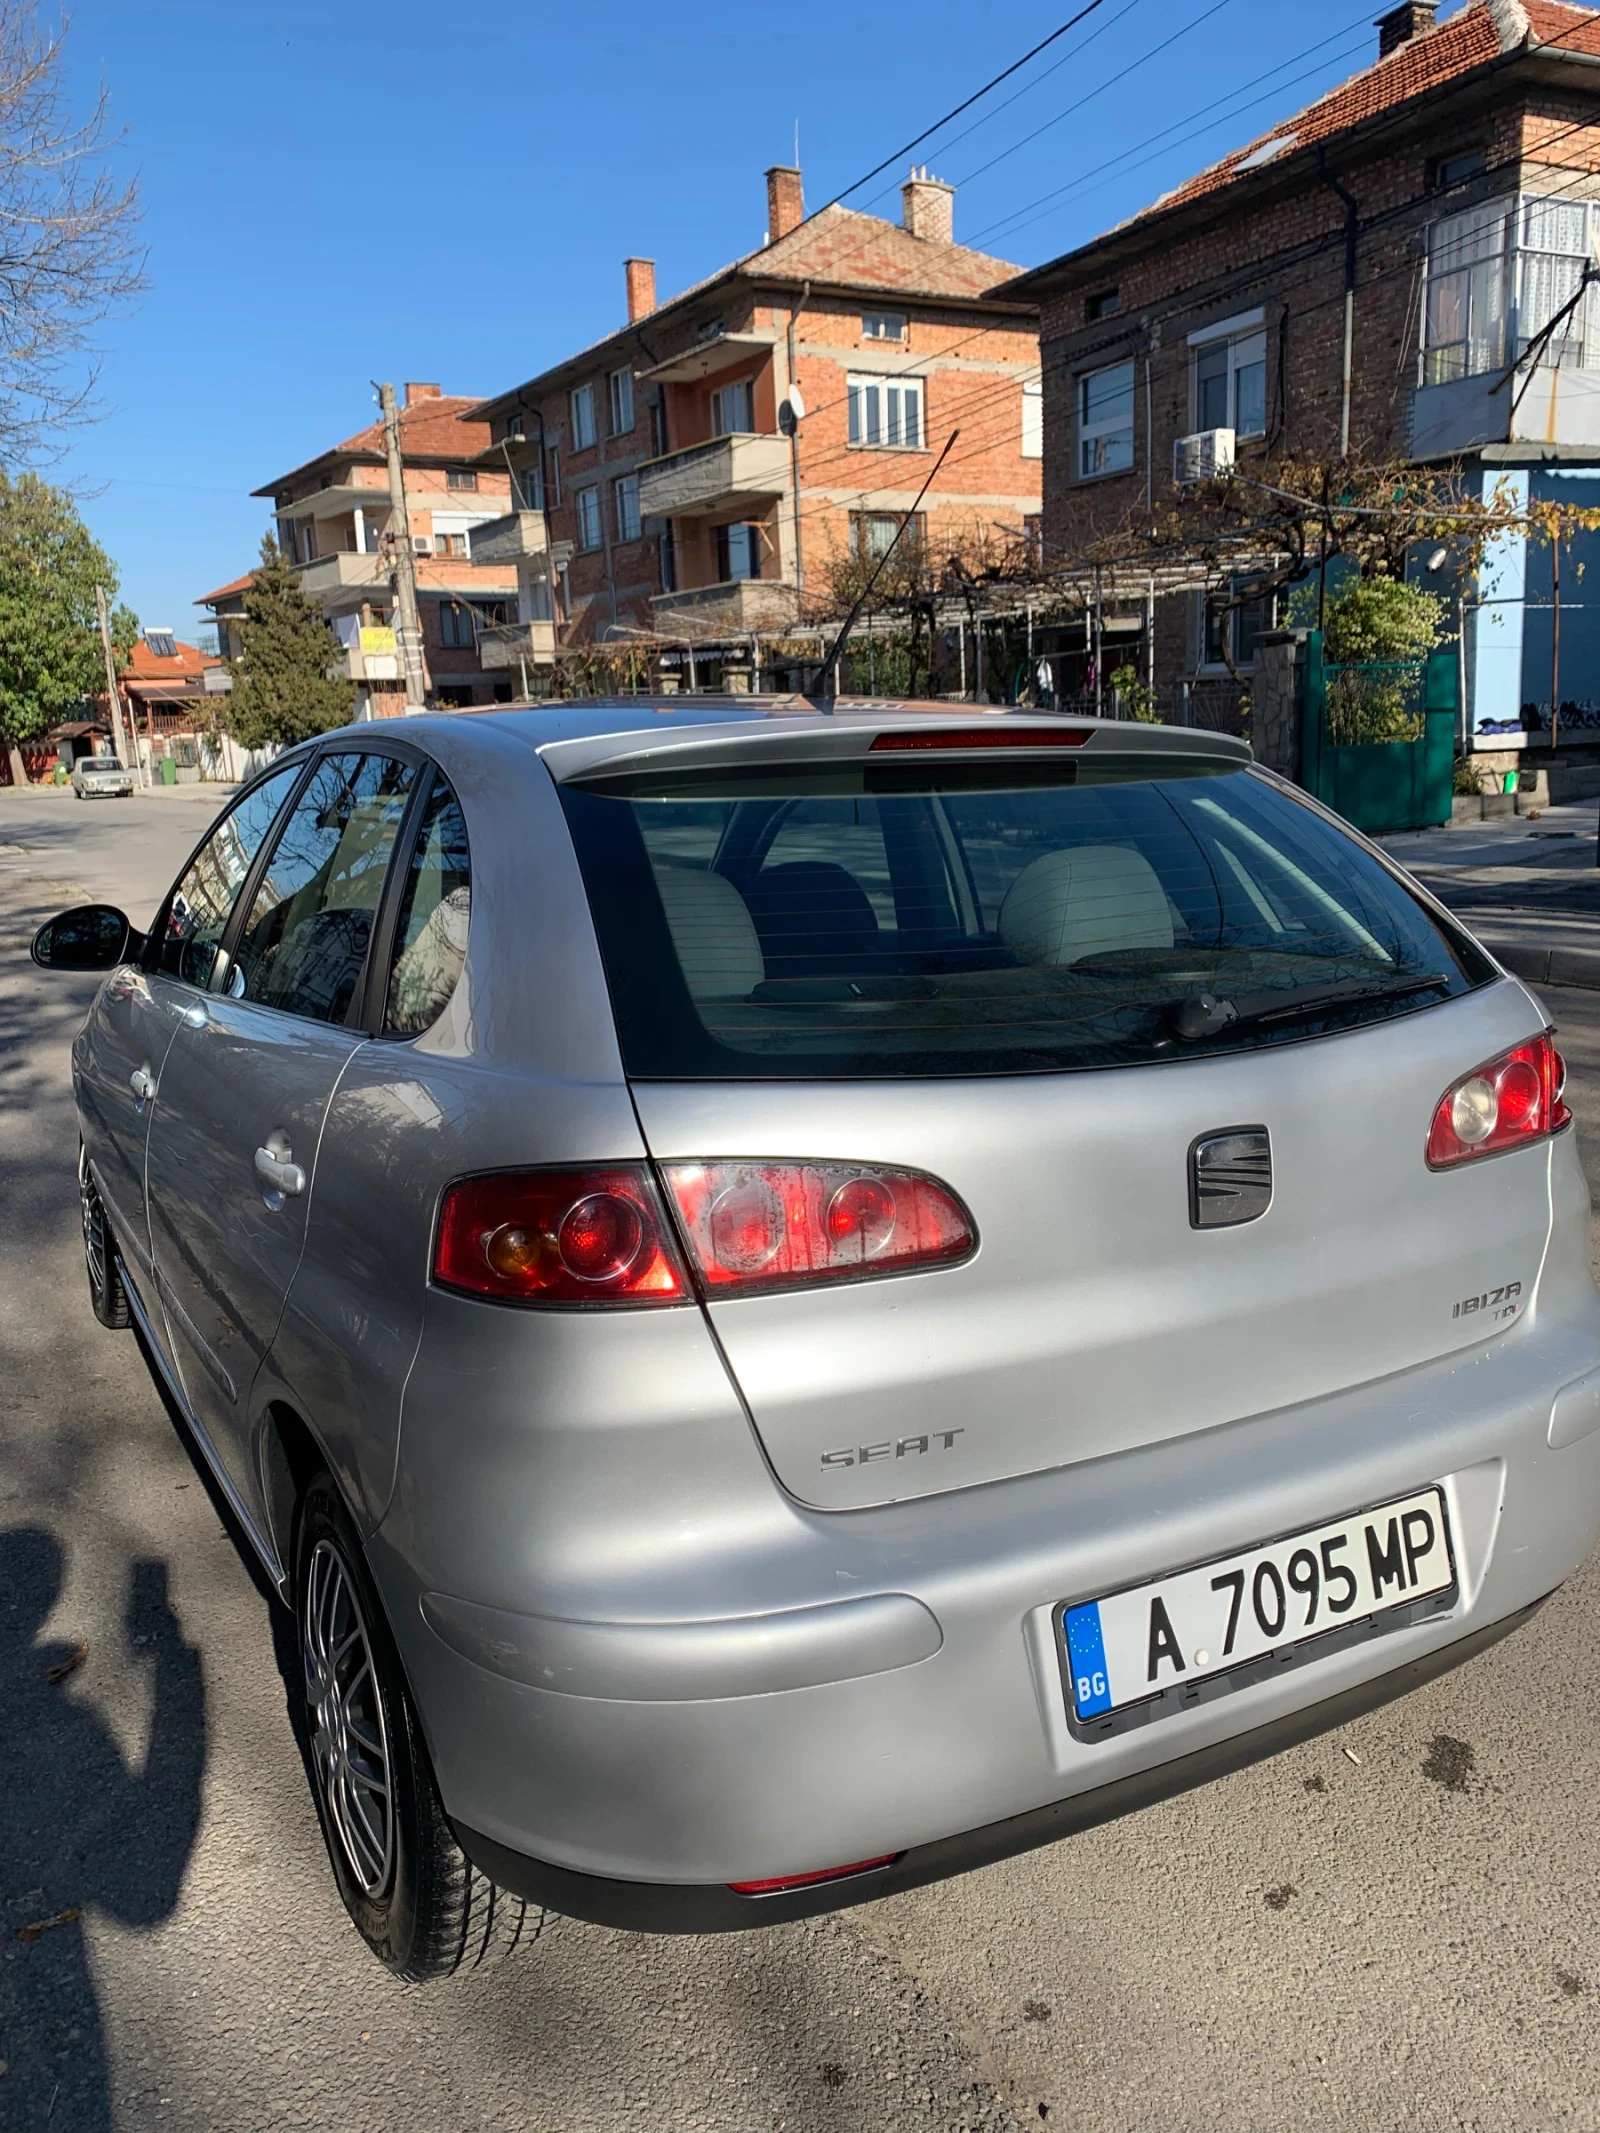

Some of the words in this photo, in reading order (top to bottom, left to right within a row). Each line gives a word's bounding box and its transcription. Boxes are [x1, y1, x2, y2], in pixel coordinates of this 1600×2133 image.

[1452, 1281, 1521, 1319] IBIZA
[821, 1428, 965, 1472] SEAT
[1147, 1596, 1186, 1682] A
[1211, 1534, 1358, 1657] 7095
[1365, 1508, 1435, 1600] MP
[1077, 1672, 1106, 1702] BG
